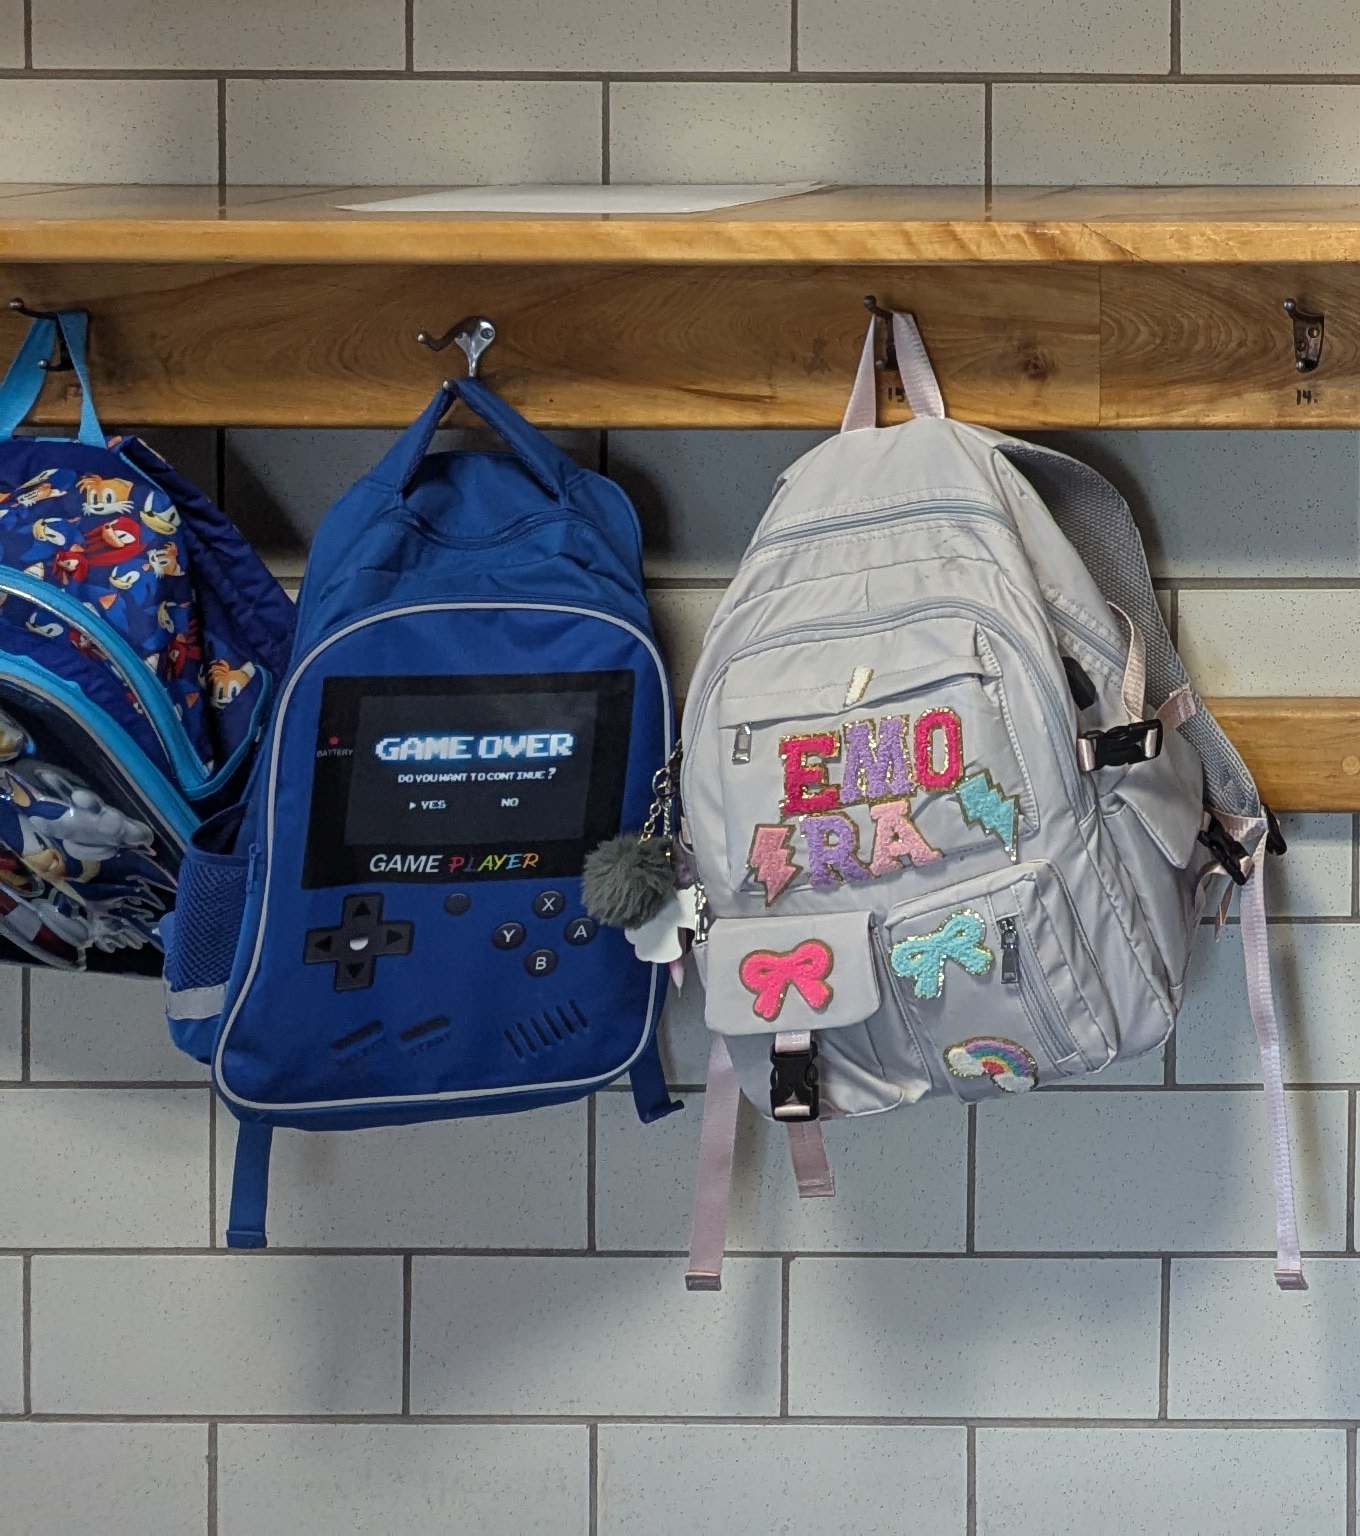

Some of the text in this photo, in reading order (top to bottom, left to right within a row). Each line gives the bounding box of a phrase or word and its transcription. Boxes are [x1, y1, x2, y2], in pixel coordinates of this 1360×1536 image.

[316, 748, 354, 757] BATTERY
[376, 734, 574, 760] GAME OVER
[778, 705, 964, 816] EMO
[398, 774, 414, 783] DO
[416, 773, 438, 782] YOU
[439, 772, 468, 782] WANT
[421, 800, 446, 810] YES
[502, 798, 519, 807] NO
[801, 799, 945, 889] RA
[370, 853, 540, 873] GAME PLAYER
[542, 898, 555, 912] X
[501, 929, 516, 943] Y
[574, 925, 587, 939] A
[535, 956, 548, 971] B
